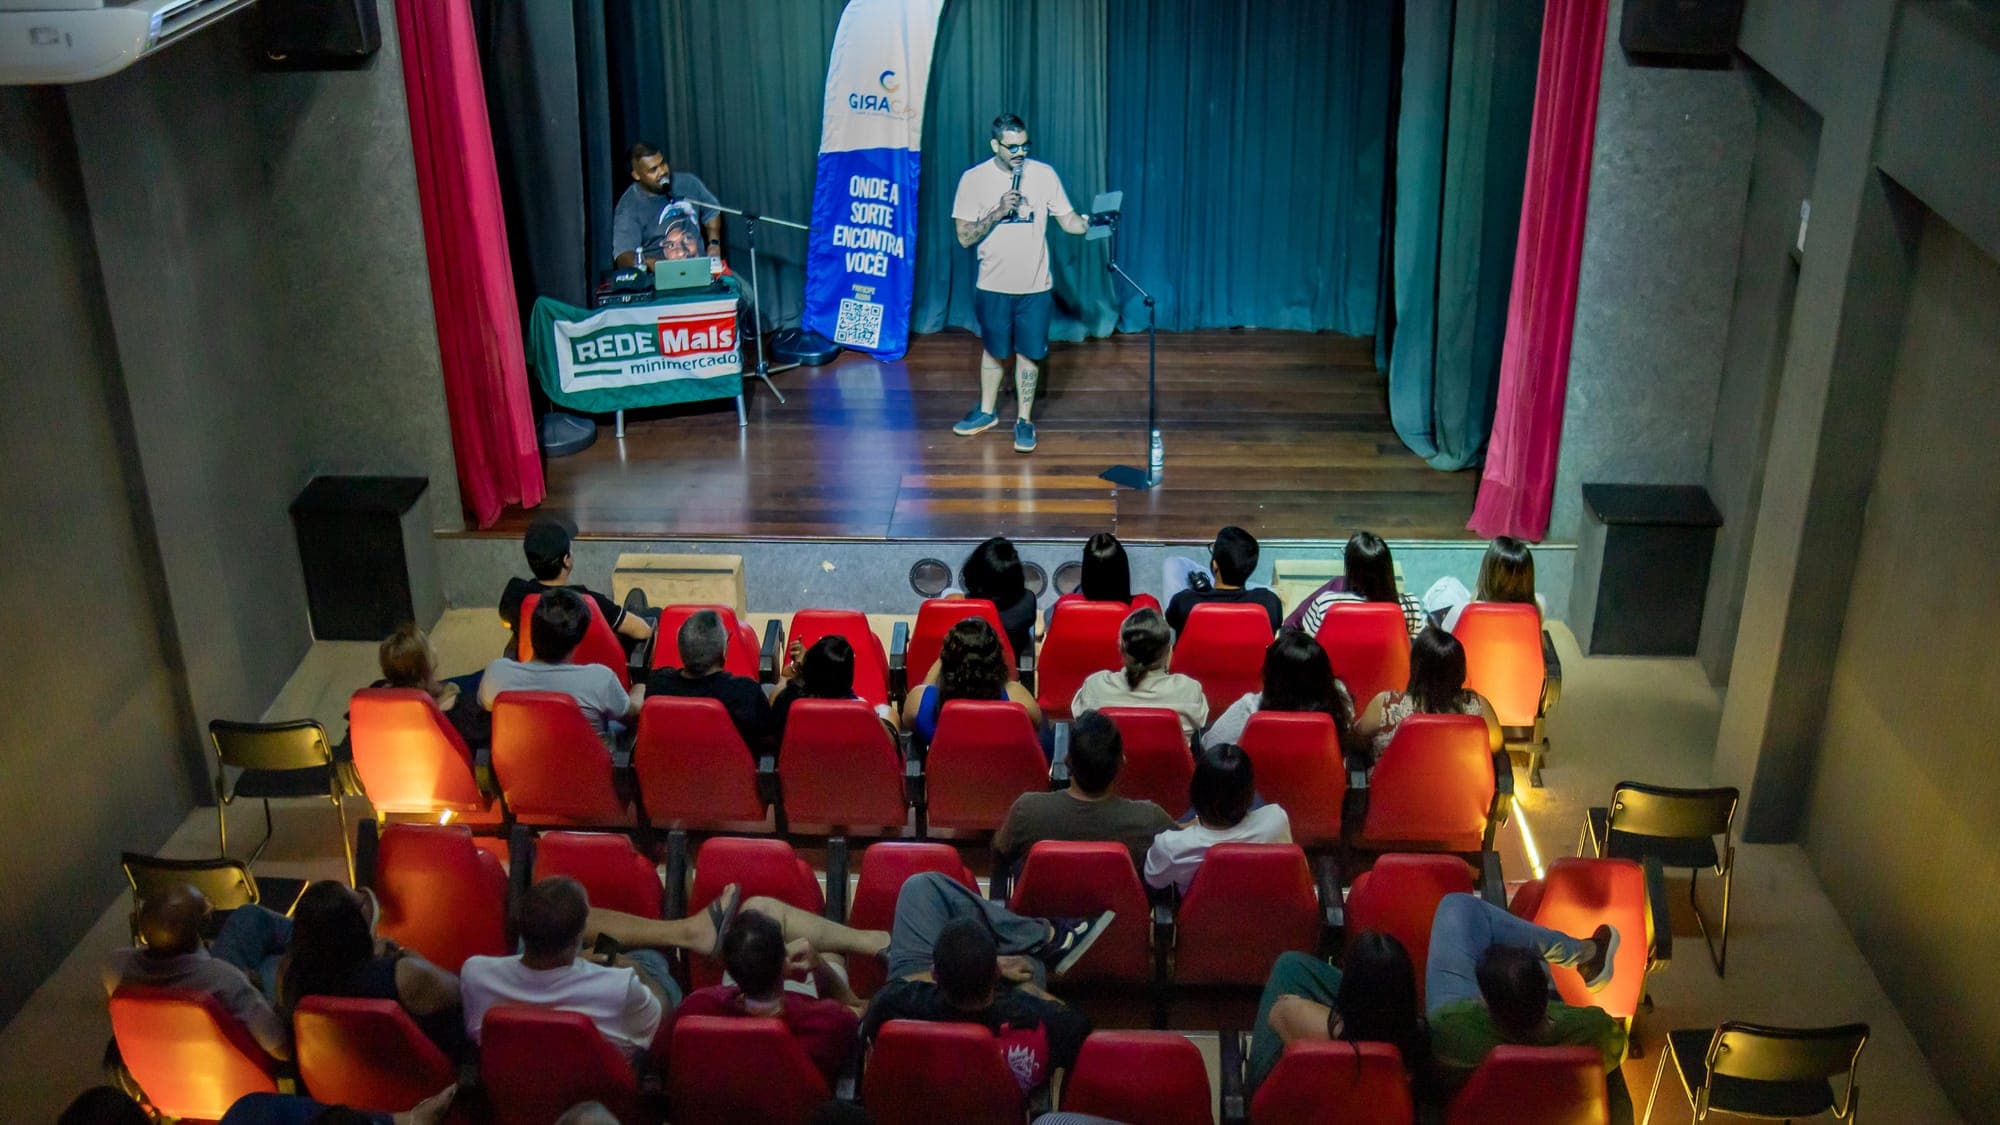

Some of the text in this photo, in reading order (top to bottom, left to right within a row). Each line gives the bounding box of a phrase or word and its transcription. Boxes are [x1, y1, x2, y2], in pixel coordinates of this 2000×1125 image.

[850, 175, 899, 205] ONDE A
[850, 202, 894, 228] SORTE
[833, 224, 905, 258] ENCONTRA
[845, 252, 888, 277] VOCÊ!
[576, 332, 655, 362] REDE
[630, 354, 737, 374] minimercado
